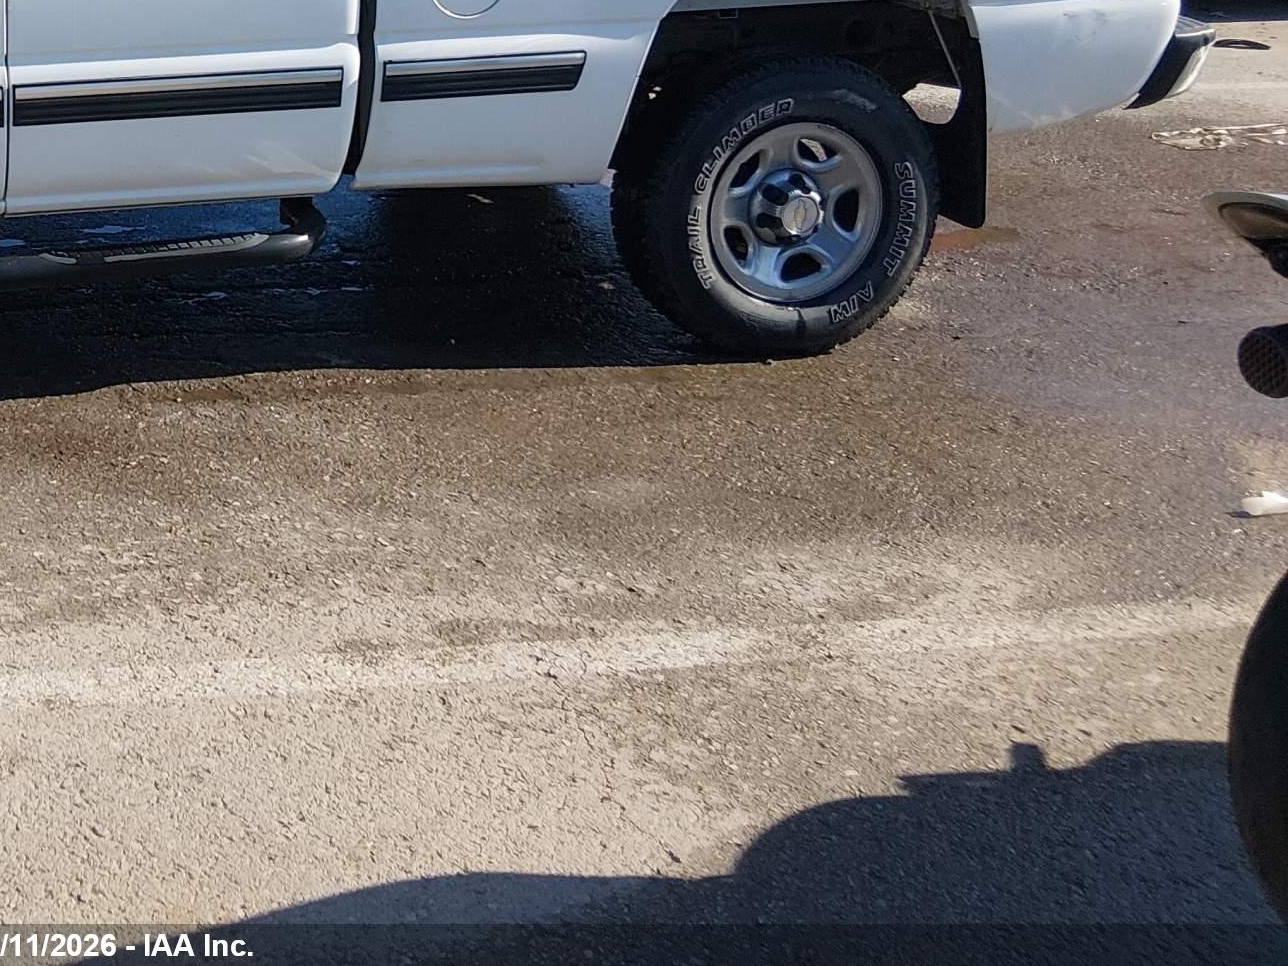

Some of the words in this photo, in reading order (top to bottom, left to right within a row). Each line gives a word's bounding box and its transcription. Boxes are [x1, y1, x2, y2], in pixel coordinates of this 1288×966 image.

[694, 98, 795, 196] CLIMBER
[687, 205, 715, 289] TRAIL
[883, 161, 917, 277] SUMMIT
